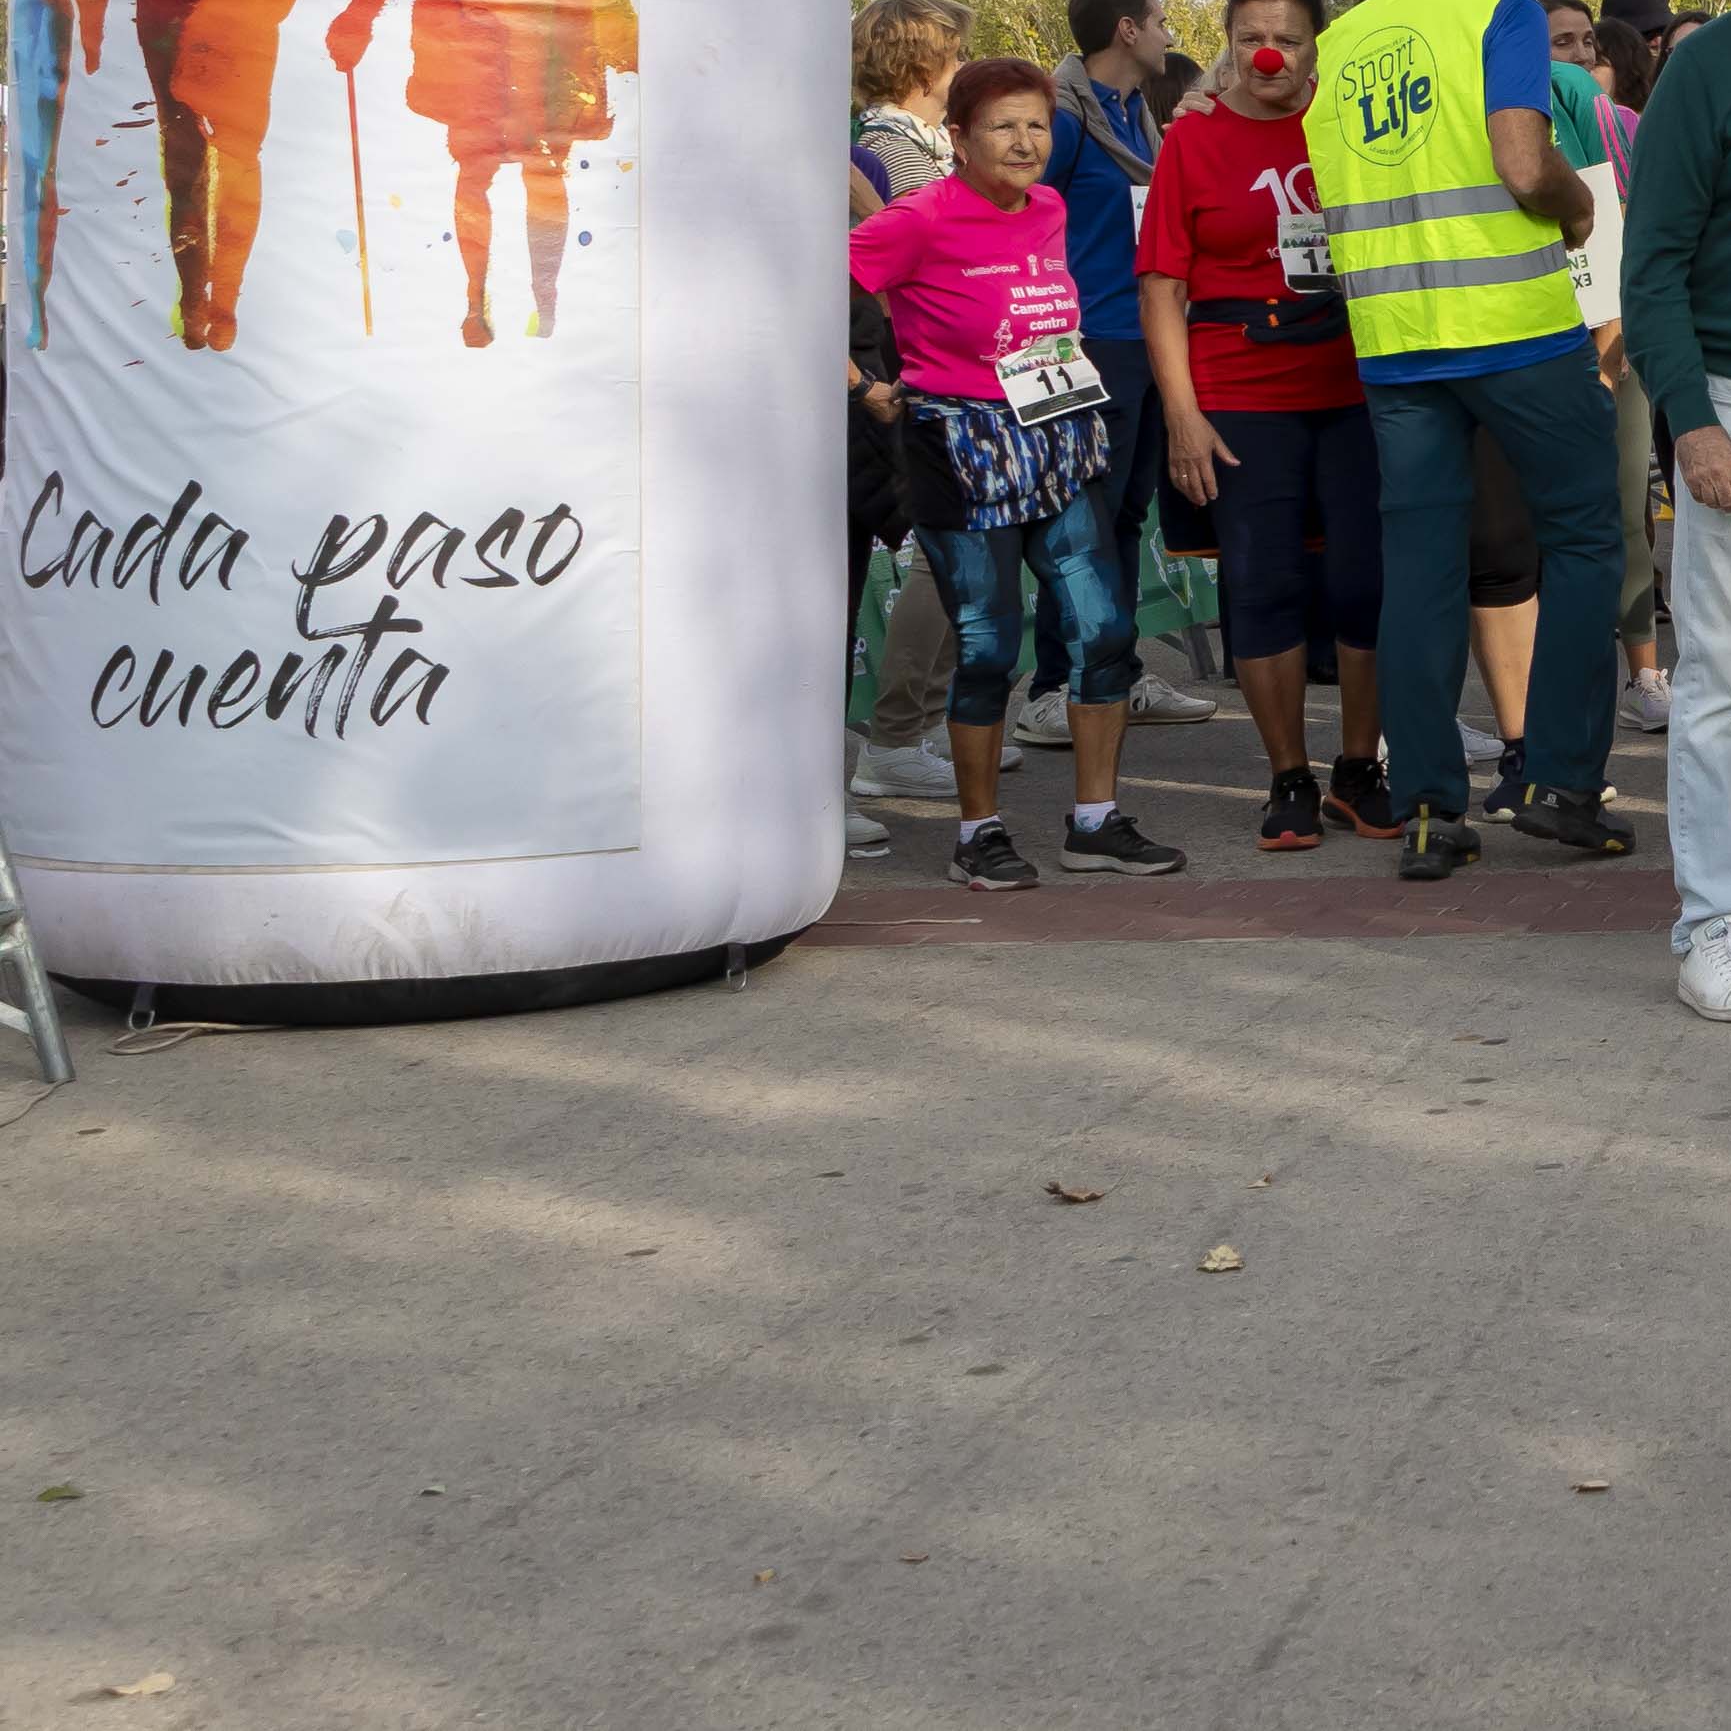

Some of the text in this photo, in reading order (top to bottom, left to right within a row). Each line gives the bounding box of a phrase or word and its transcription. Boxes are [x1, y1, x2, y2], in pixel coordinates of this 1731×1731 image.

[1342, 35, 1416, 101] Sport
[1358, 70, 1433, 144] Life
[1010, 298, 1077, 316] Campo Real
[1028, 284, 1067, 296] Marcha
[1029, 317, 1068, 331] contra
[1036, 365, 1074, 396] 11
[20, 471, 584, 640] Cada paso
[90, 594, 450, 740] cuenta
